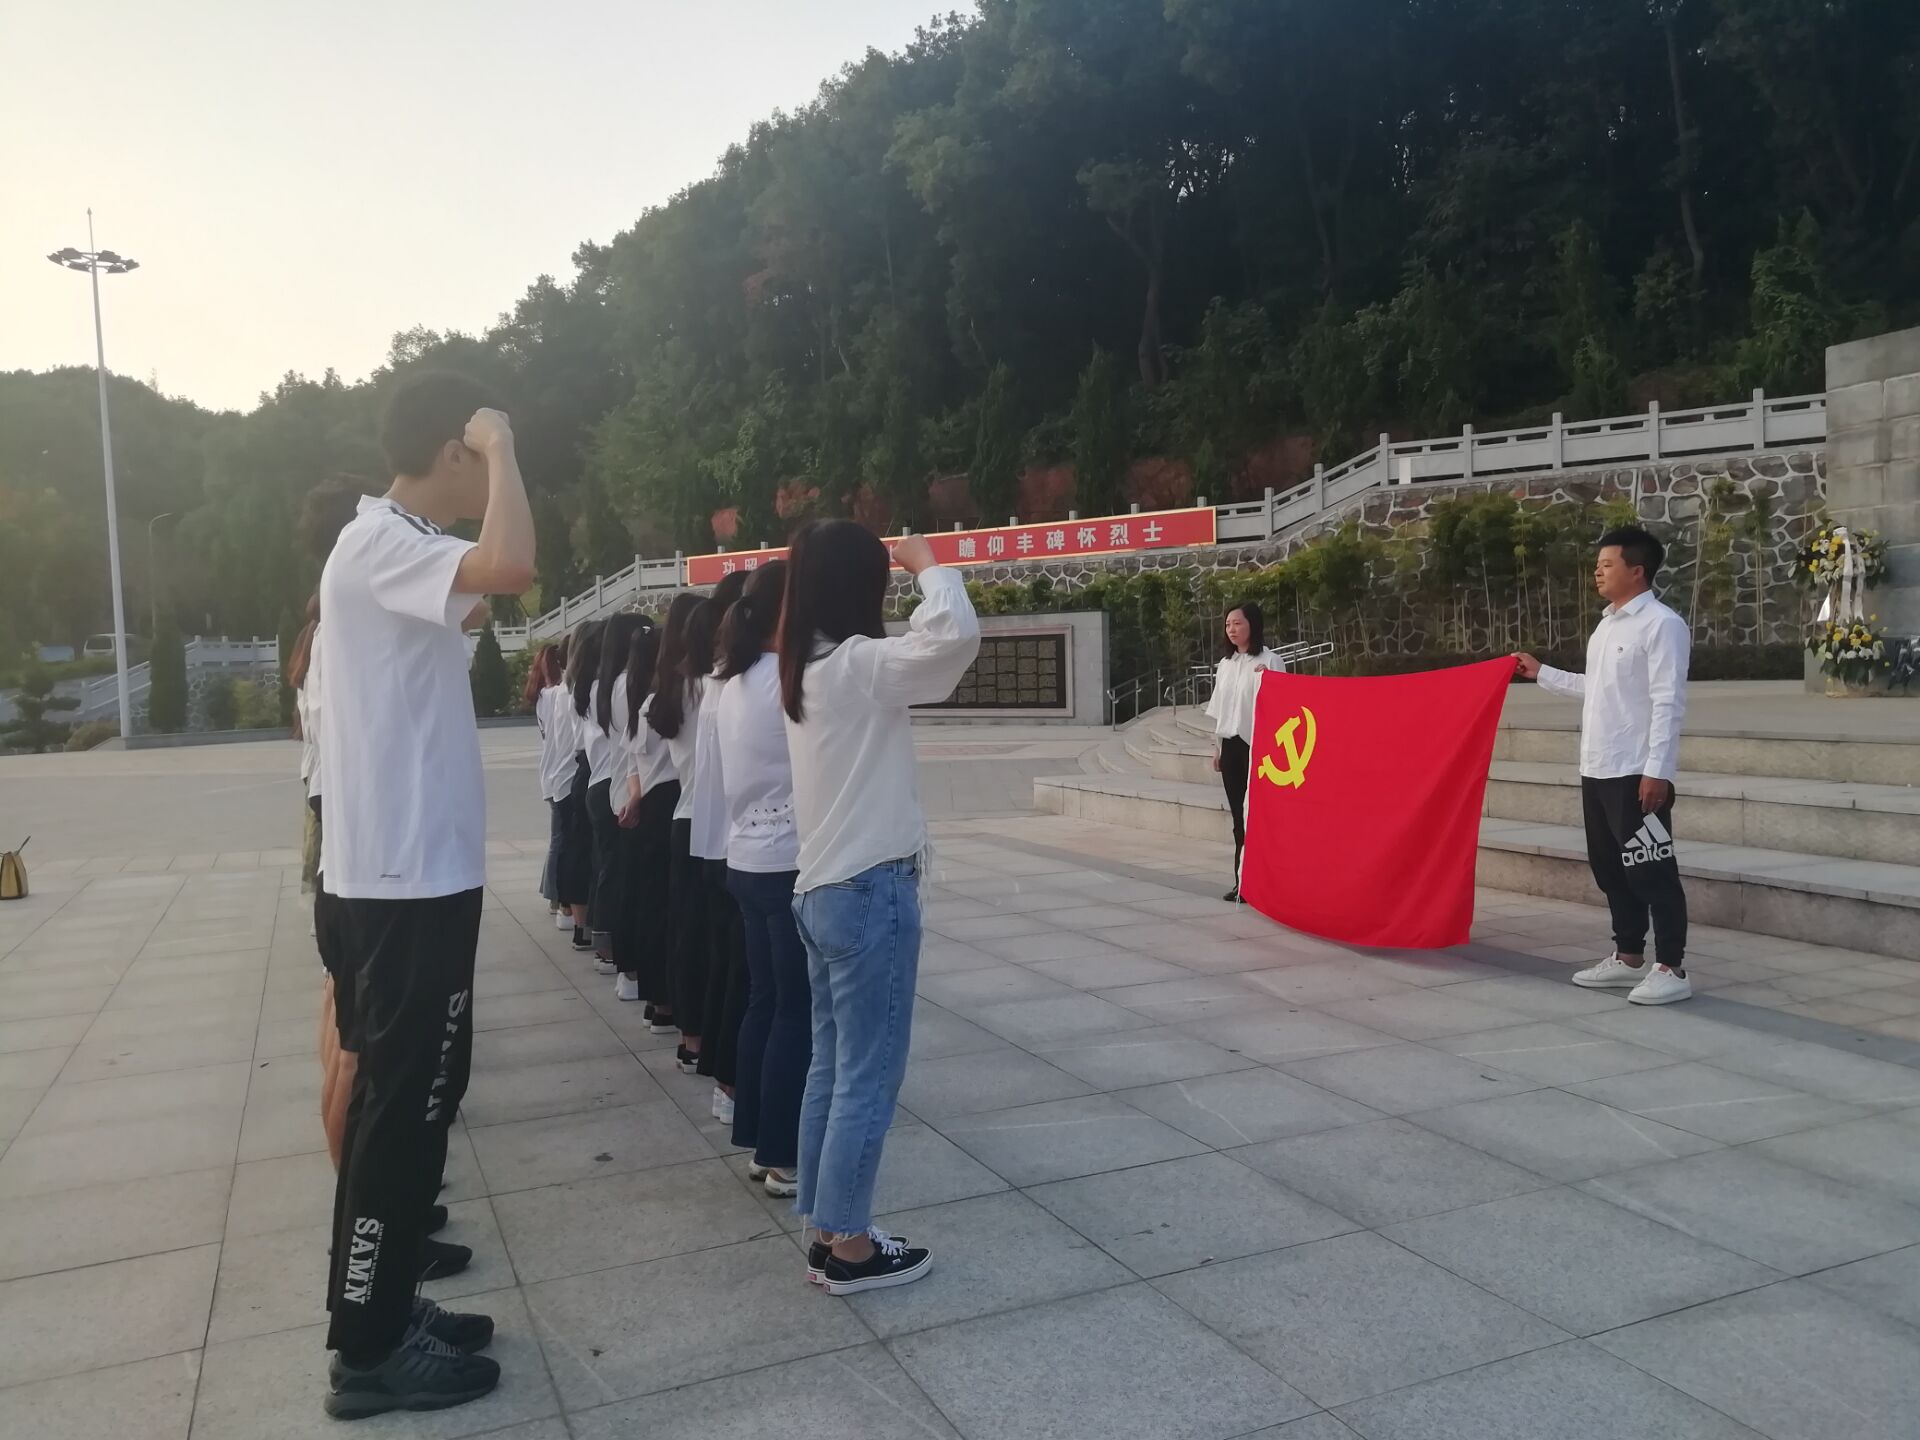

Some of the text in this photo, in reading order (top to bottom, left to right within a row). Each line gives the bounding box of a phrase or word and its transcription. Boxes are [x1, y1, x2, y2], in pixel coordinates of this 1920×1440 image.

[958, 520, 1163, 558] 瞻仰丰碑怀烈士
[1621, 842, 1673, 867] adida
[344, 1217, 380, 1304] SAMN
